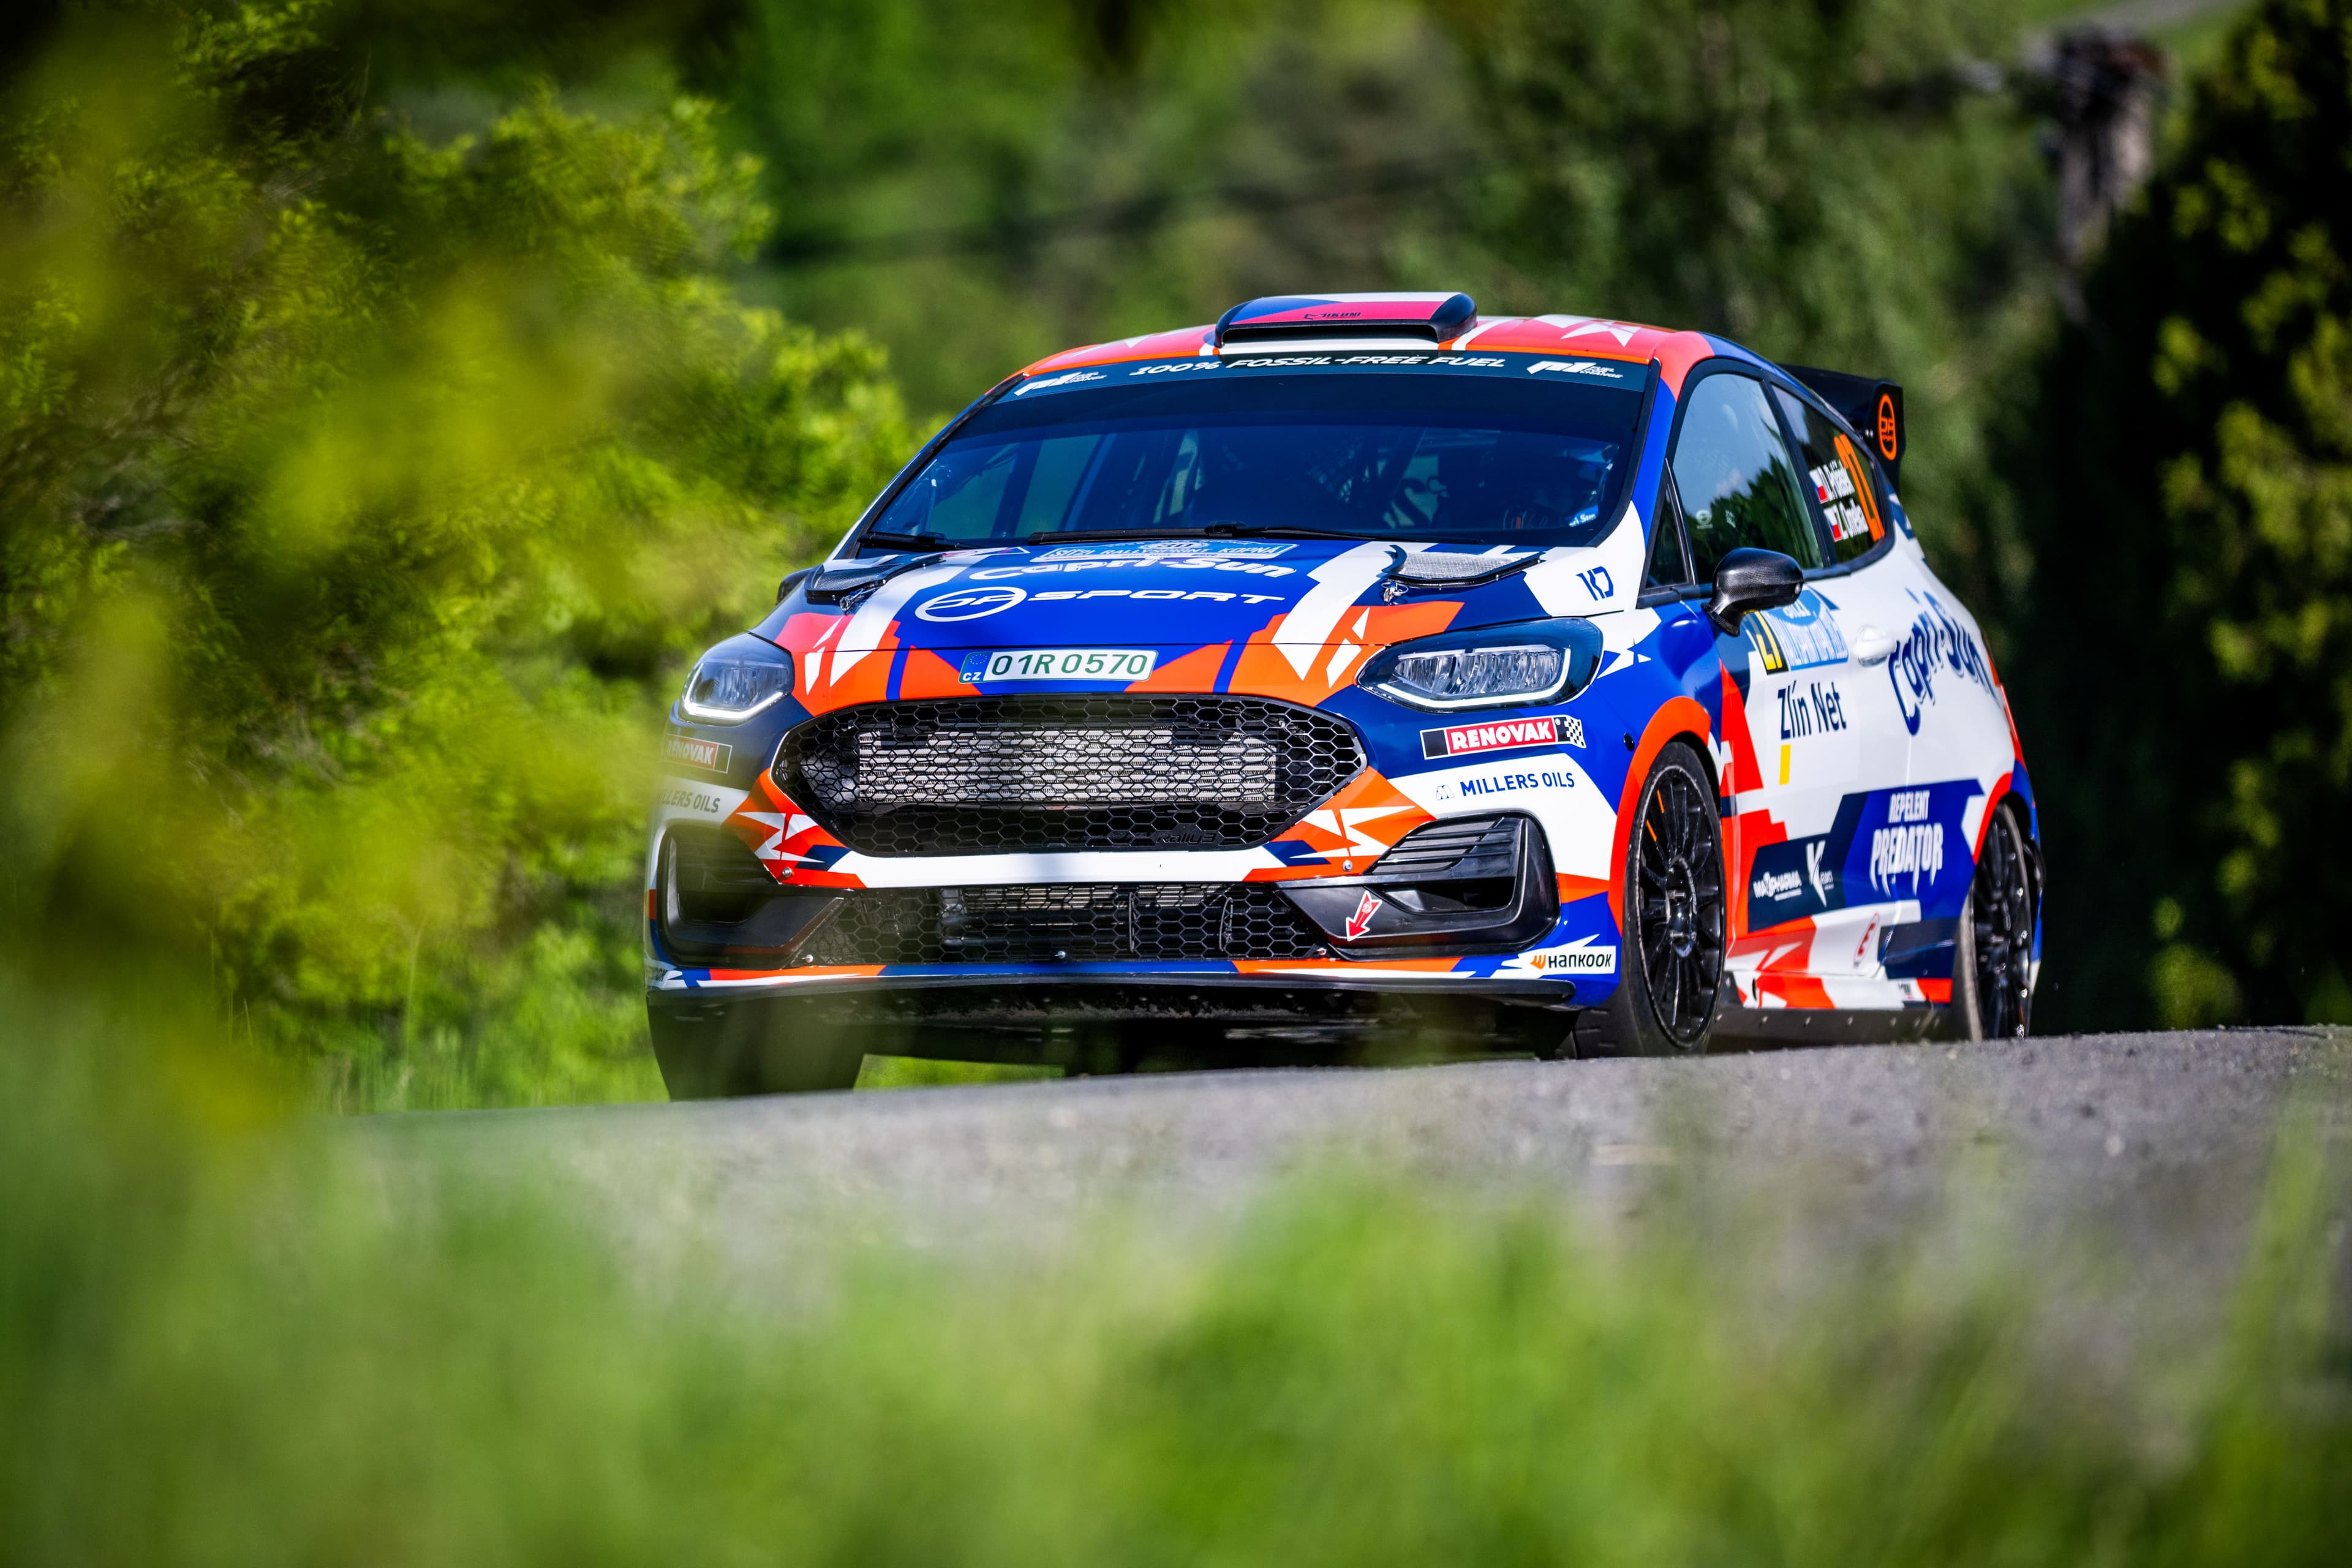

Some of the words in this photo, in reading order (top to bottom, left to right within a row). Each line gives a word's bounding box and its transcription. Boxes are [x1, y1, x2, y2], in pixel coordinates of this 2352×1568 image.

[1129, 362, 1222, 375] 100%
[1226, 356, 1429, 368] FOSSIL-FREE
[1427, 357, 1506, 367] FUEL
[969, 557, 1297, 580] Capri-Sun
[1027, 590, 1286, 604] SPORT
[991, 654, 1055, 676] 01R
[1061, 654, 1148, 675] 0570
[1888, 586, 2001, 737] Capri-Sun
[962, 671, 982, 681] CZ
[1777, 679, 1812, 740] Zlín
[1811, 681, 1847, 733] Net
[1450, 721, 1553, 750] RENOVAK
[1460, 773, 1539, 797] MILLERS
[1542, 772, 1575, 788] OILS
[693, 793, 721, 813] OILS
[1888, 790, 1931, 824] REPELENT
[1156, 832, 1216, 845] Rally3
[1869, 822, 1943, 898] PREDATOR
